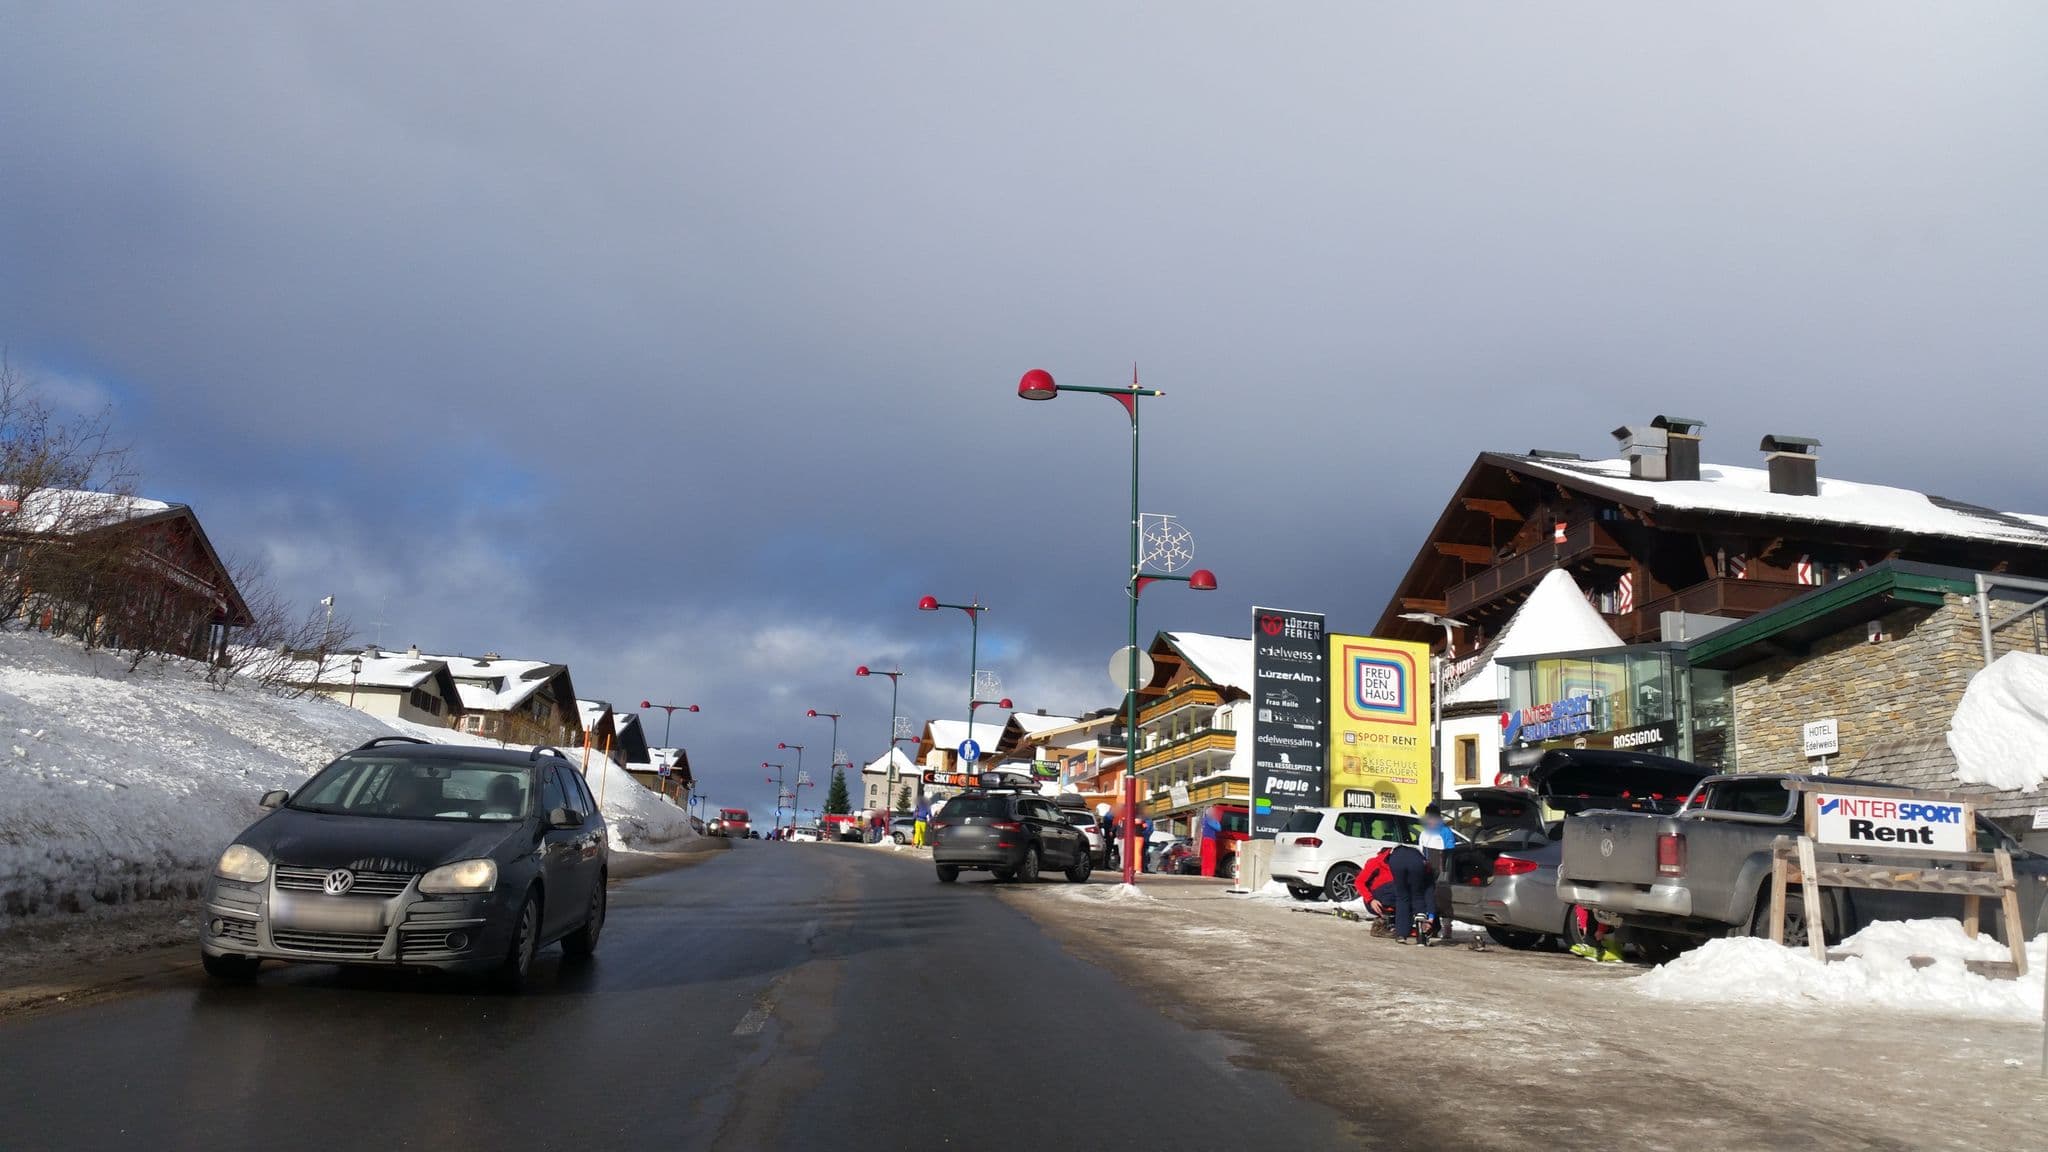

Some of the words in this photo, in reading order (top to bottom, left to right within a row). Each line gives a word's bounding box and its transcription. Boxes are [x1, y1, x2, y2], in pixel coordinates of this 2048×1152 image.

[1285, 617, 1320, 630] LÜRZER
[1285, 628, 1320, 640] FERIEN
[1260, 646, 1313, 660] edelweiss
[1259, 669, 1314, 682] LürzerAlm
[1365, 668, 1391, 679] FREU
[1365, 678, 1388, 689] DEN
[1365, 689, 1396, 701] HAUS
[1522, 694, 1590, 726] INTERSPORT
[1809, 726, 1832, 736] HOTEL
[1258, 734, 1313, 747] edelweissalm
[1358, 732, 1389, 743] SPORT
[1392, 736, 1417, 746] RENT
[1613, 728, 1663, 749] ROSSIGNOL
[1806, 740, 1837, 751] Edelweiss
[1257, 761, 1274, 769] HOTEL
[1275, 762, 1313, 772] KESSELSPITZE
[1363, 757, 1417, 770] SKISCHULE
[1362, 765, 1418, 777] OBERTAUERN
[934, 773, 981, 787] SKIWORL
[1265, 776, 1309, 794] People
[1347, 793, 1371, 807] MUND
[1840, 798, 1962, 824] INTERSPORT
[1849, 819, 1934, 845] Rent
